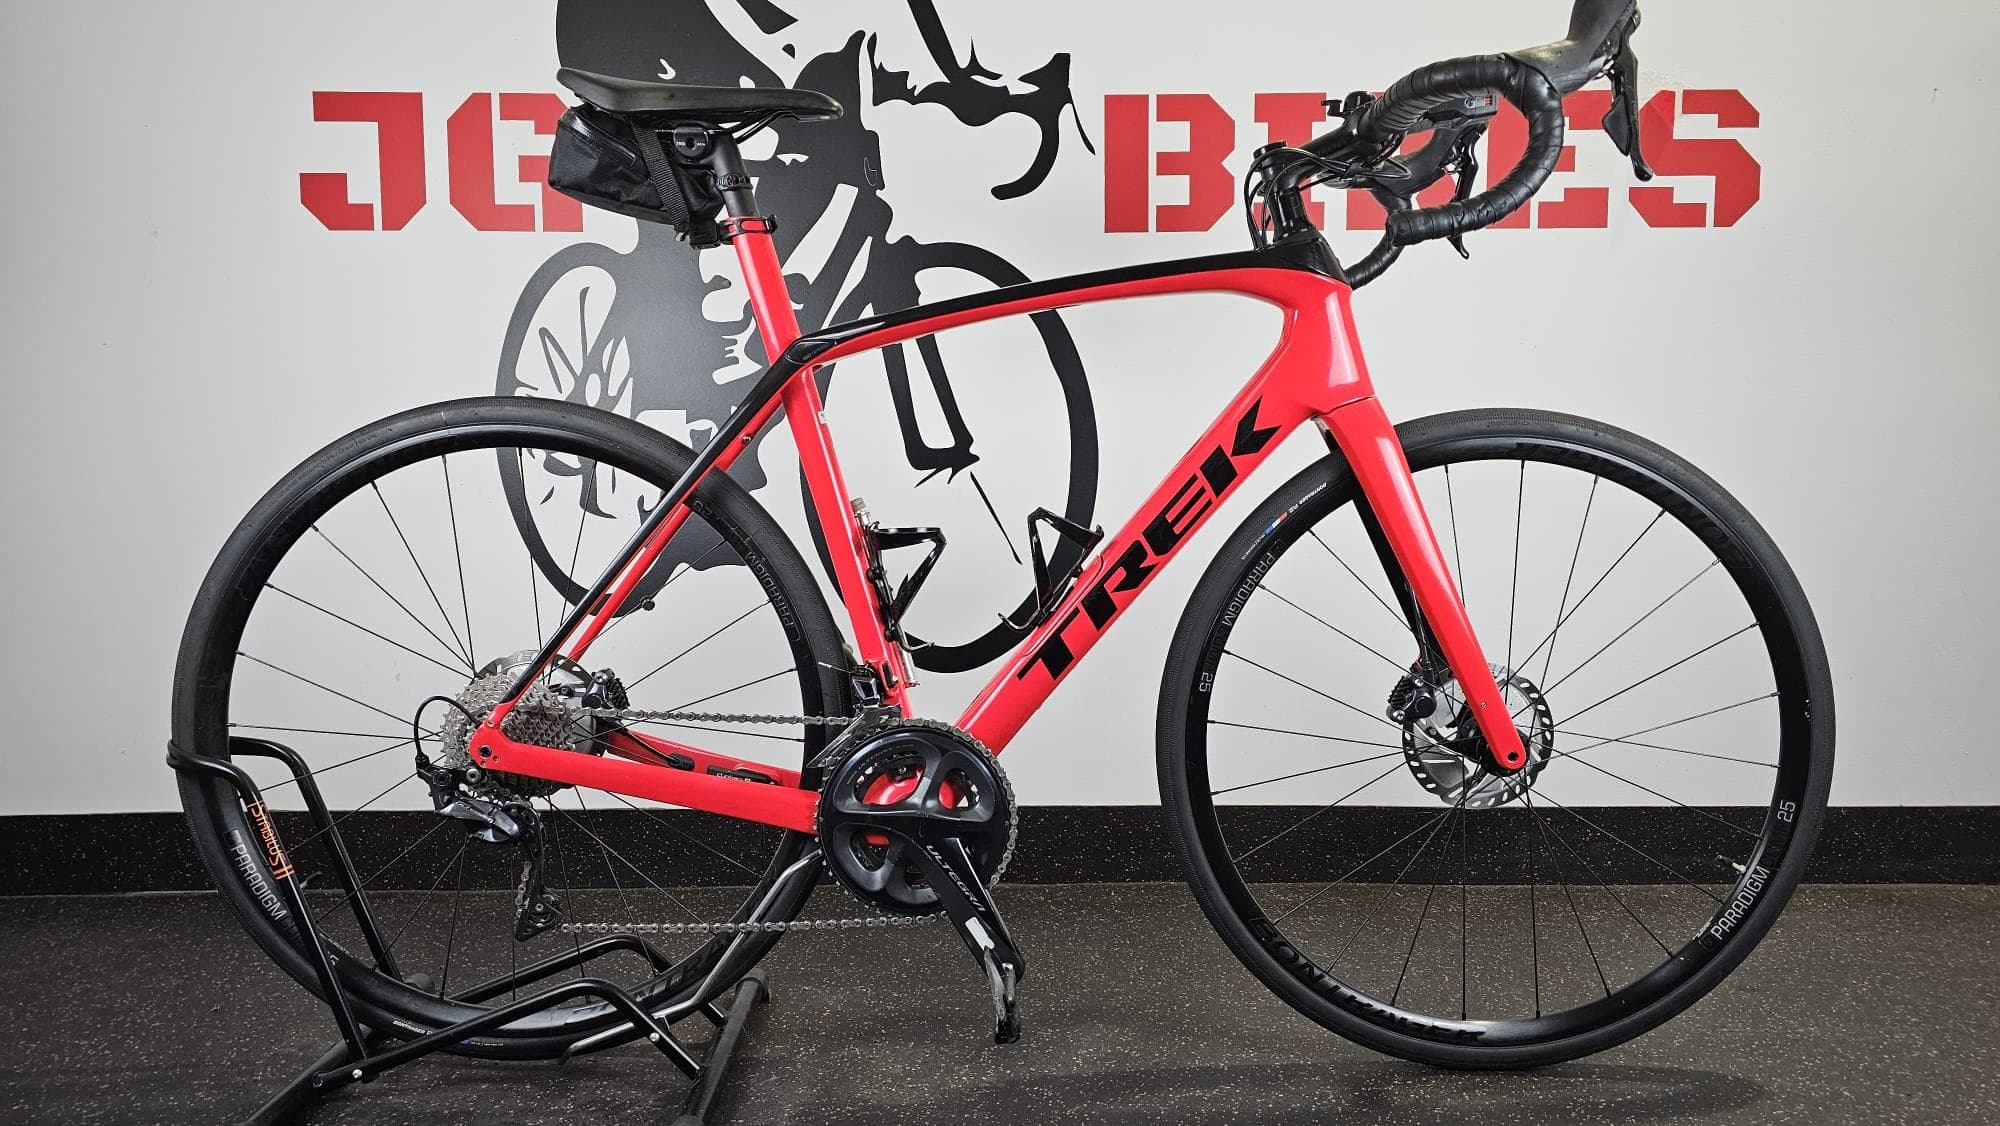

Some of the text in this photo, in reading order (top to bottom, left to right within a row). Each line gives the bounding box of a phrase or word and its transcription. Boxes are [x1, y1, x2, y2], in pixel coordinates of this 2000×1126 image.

[299, 91, 583, 232] JG
[1017, 395, 1283, 680] TREK
[1222, 552, 1276, 626] PARADIGM
[1199, 672, 1213, 693] 25
[231, 844, 287, 921] PARADIGM
[926, 845, 986, 912] ULTEGRA
[1710, 865, 1771, 940] PARADIGM
[1777, 800, 1796, 822] 25
